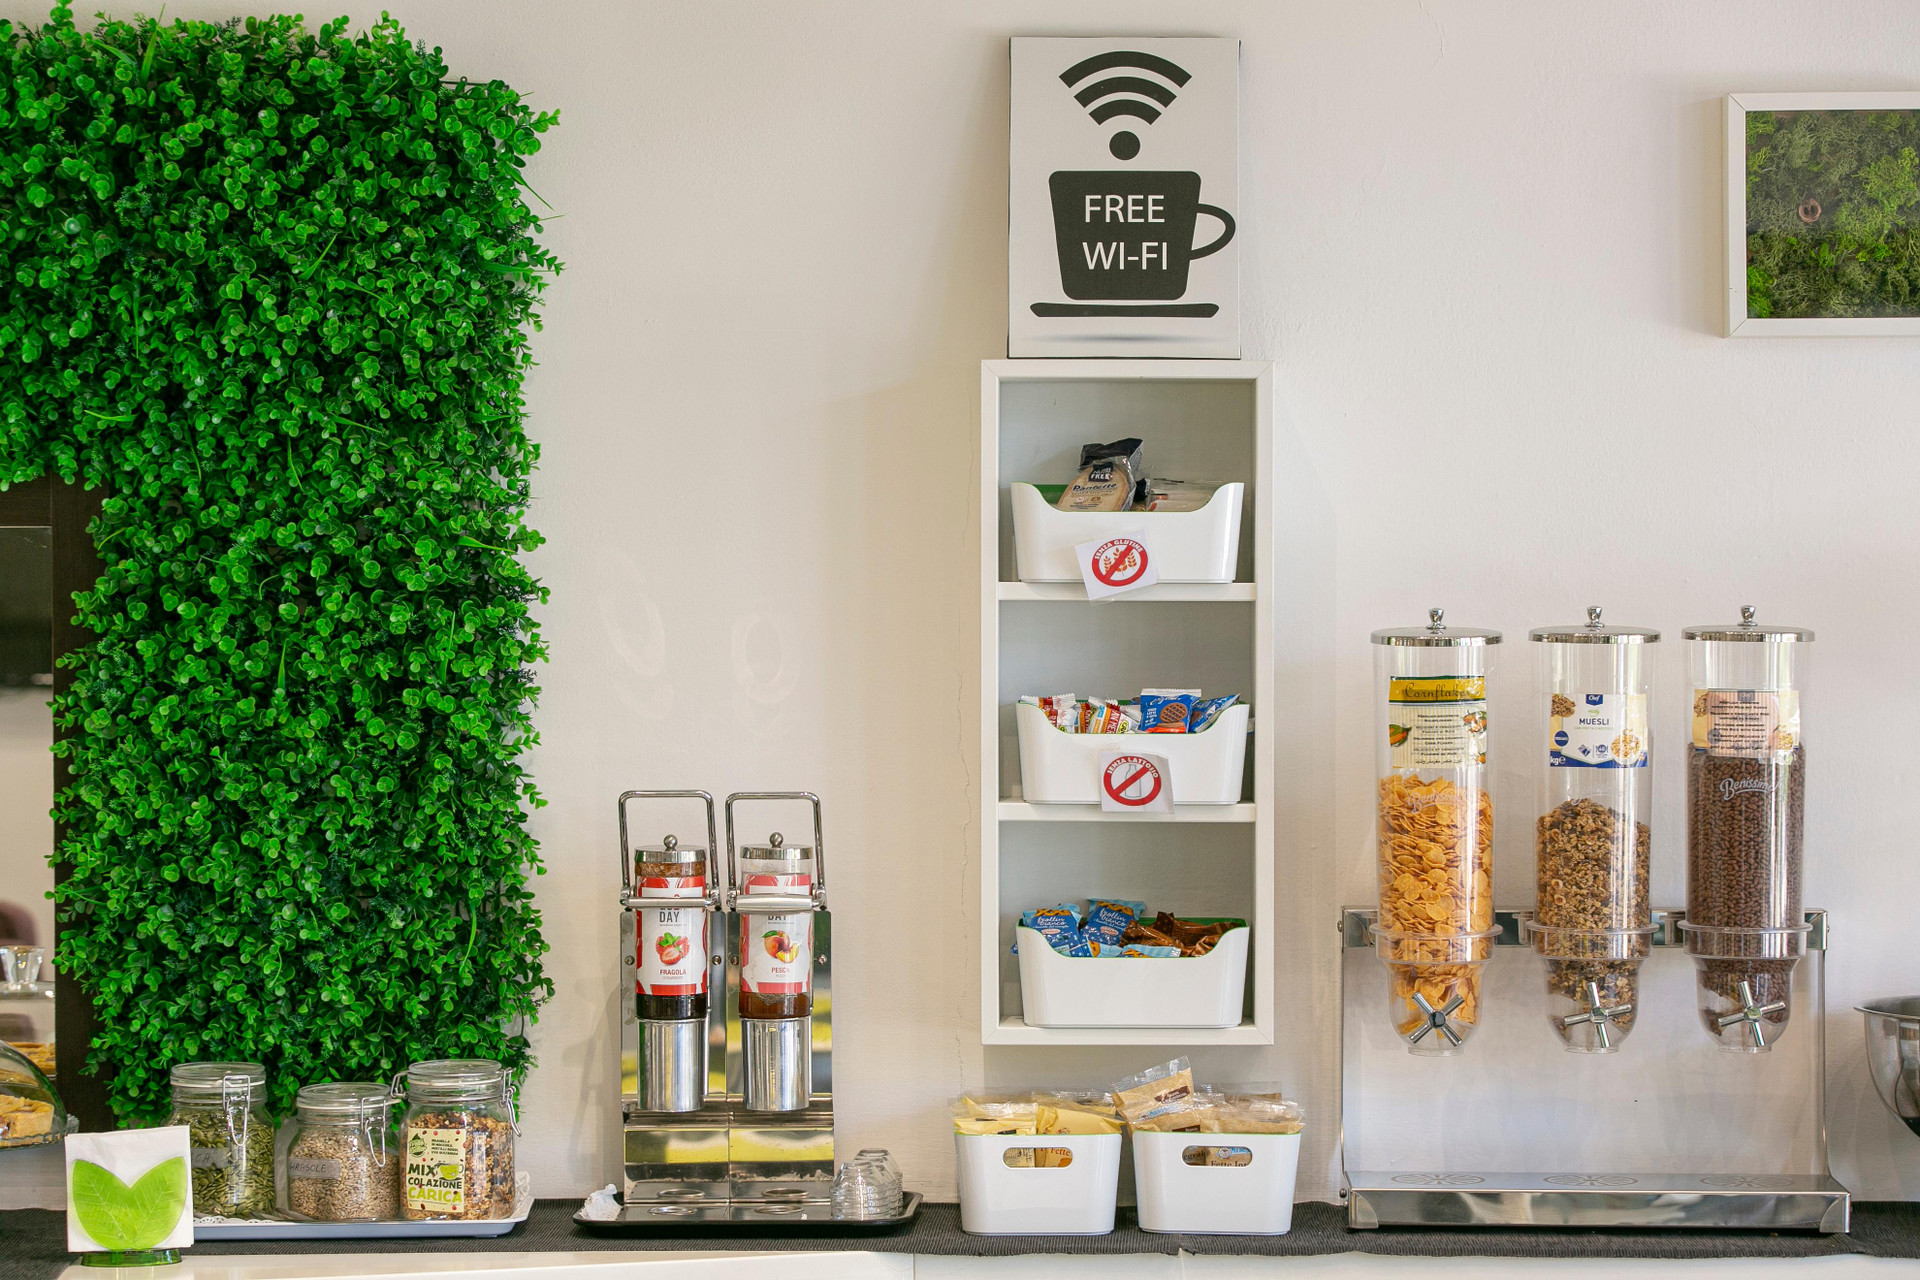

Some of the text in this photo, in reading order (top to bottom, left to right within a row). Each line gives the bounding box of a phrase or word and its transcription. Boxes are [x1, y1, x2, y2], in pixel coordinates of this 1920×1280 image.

[1085, 195, 1165, 223] FREE
[1082, 242, 1168, 270] WI-FI
[1094, 539, 1144, 559] SENZA GLUTINE
[1107, 757, 1159, 778] SENZA LATTOSIO
[1720, 777, 1779, 801] Benissimo
[659, 911, 680, 923] DAY
[408, 1163, 435, 1176] MIX
[408, 1177, 462, 1190] COLAZIONE
[408, 1186, 462, 1203] CARICA
